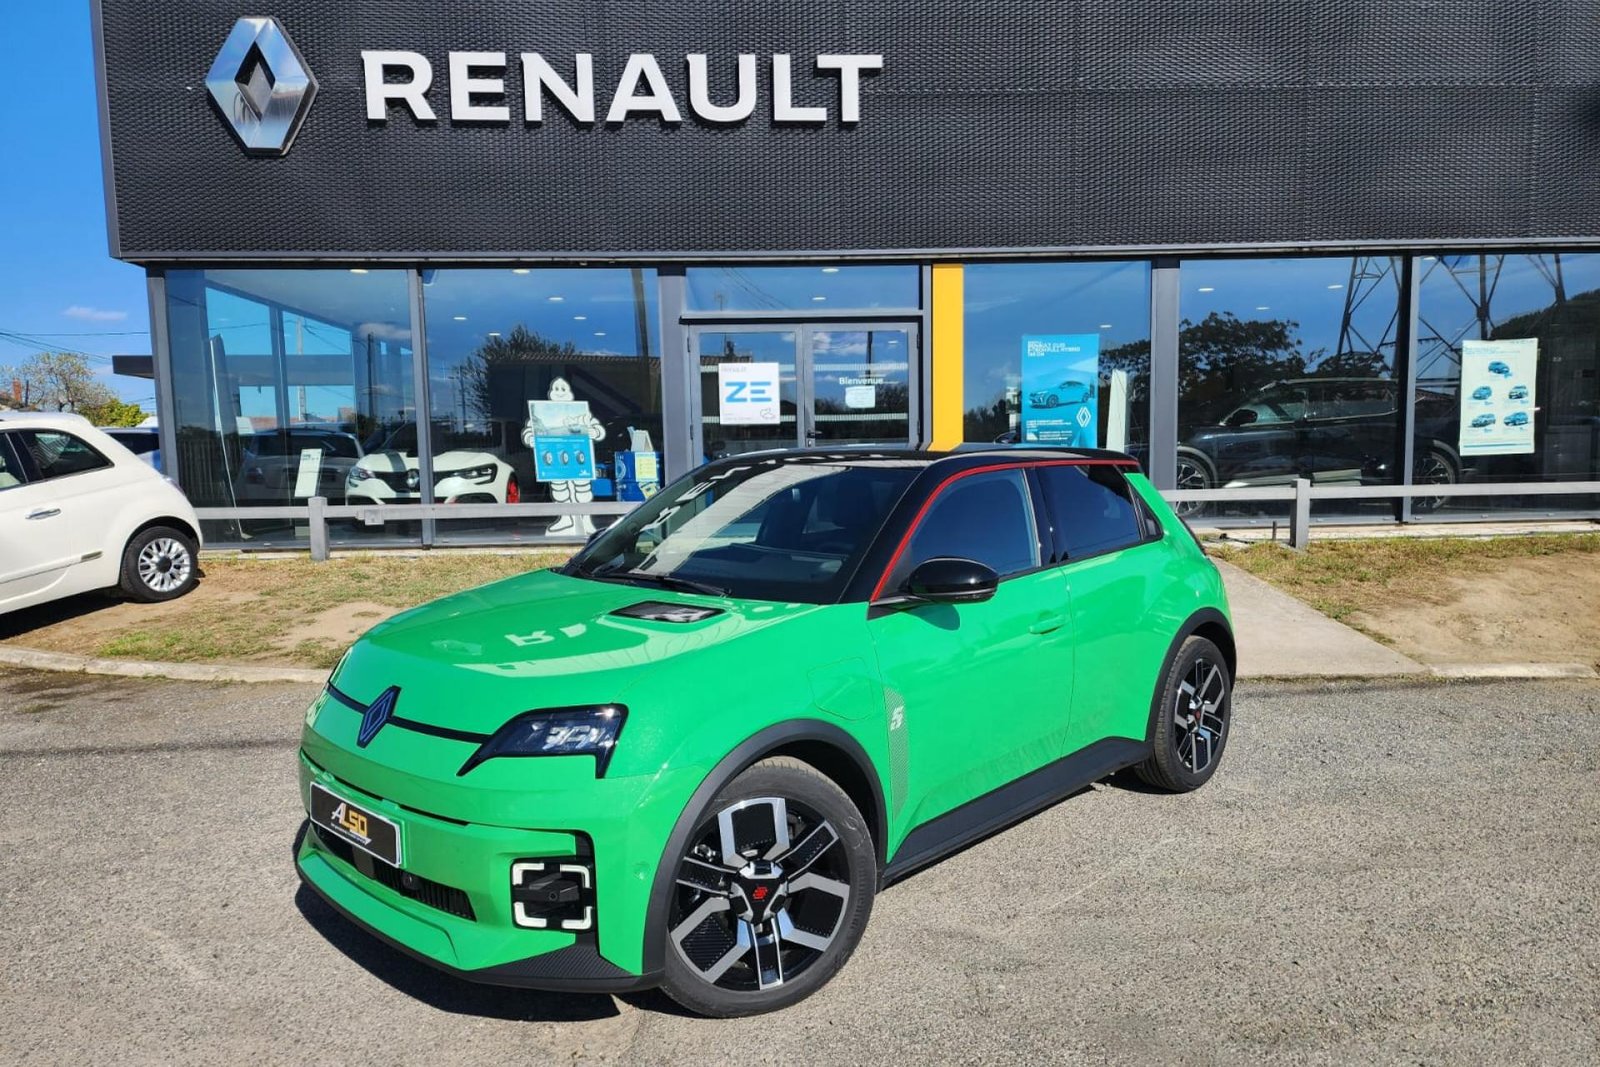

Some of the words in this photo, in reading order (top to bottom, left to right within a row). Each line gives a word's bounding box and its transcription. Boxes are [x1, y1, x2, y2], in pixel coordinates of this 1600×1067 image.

[361, 50, 884, 125] RENAULT
[725, 381, 772, 404] ZE
[838, 376, 884, 386] Bienvenue
